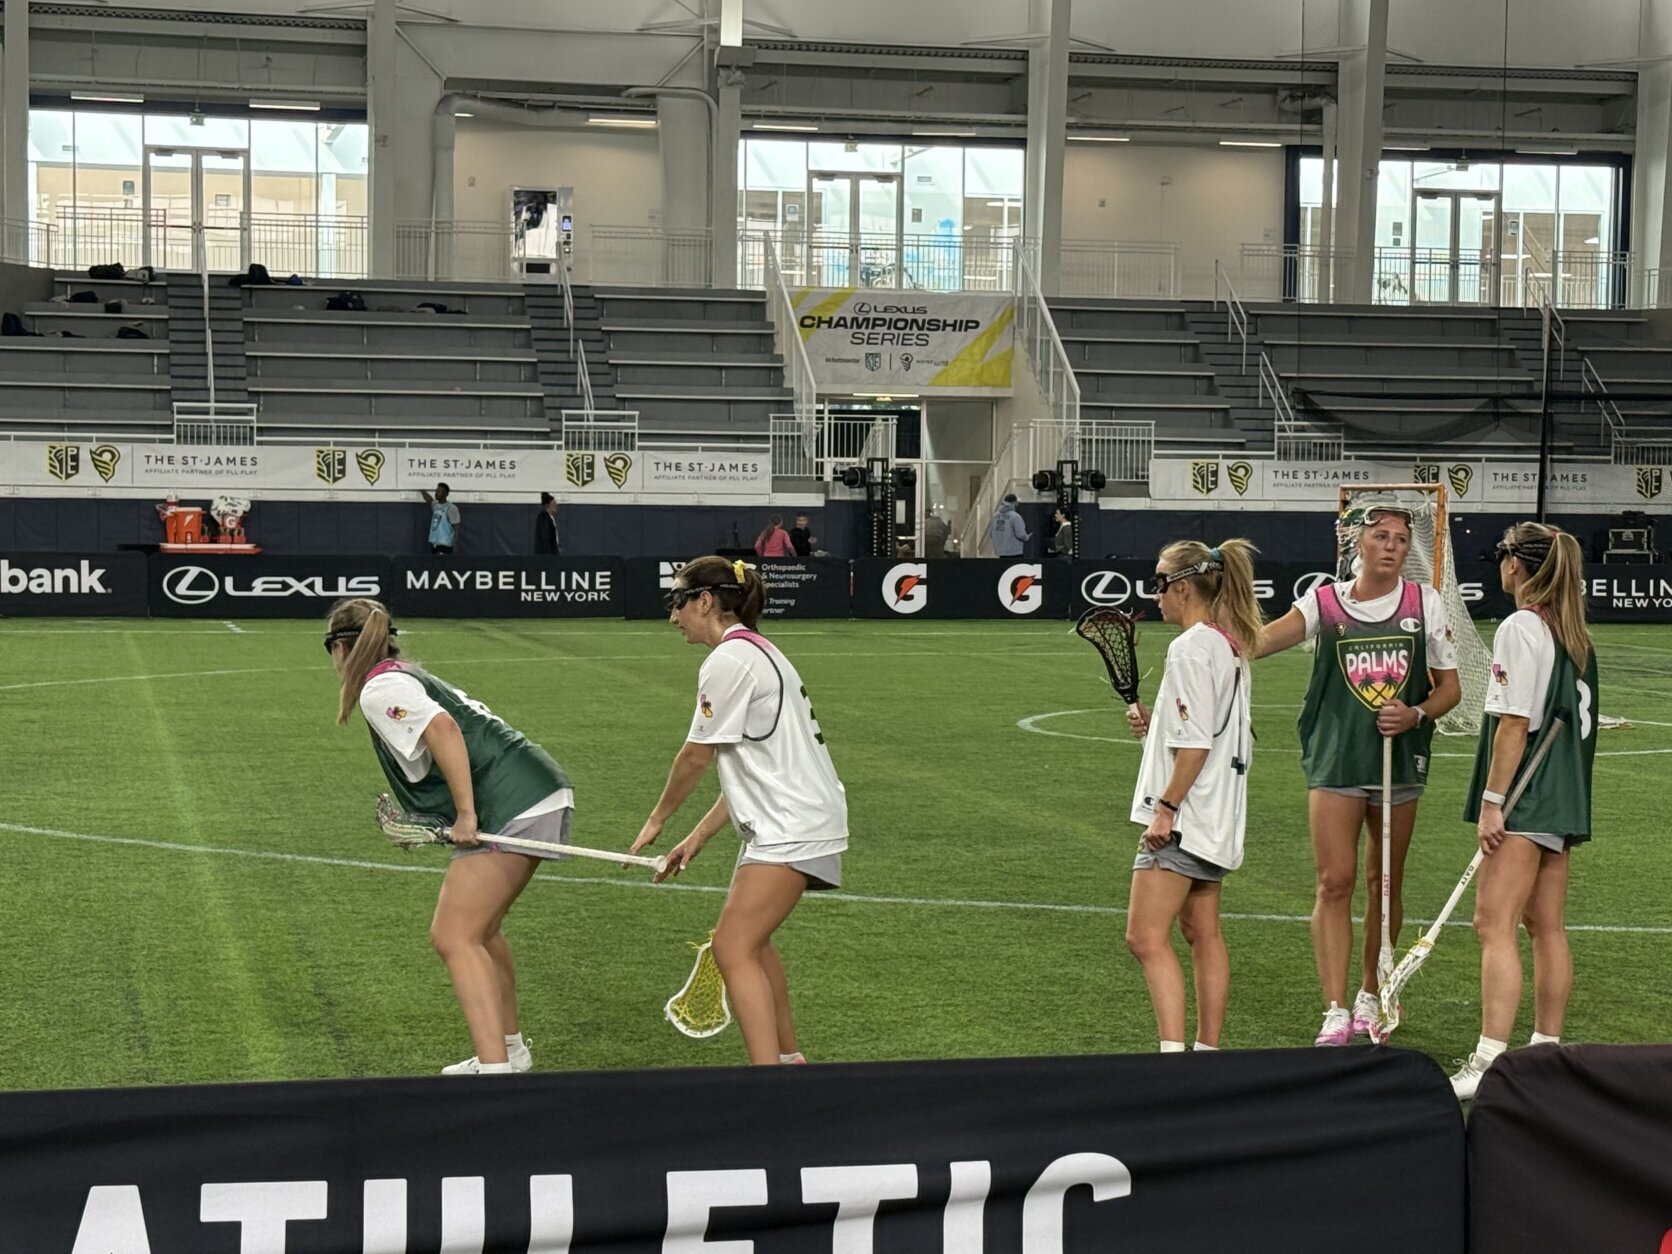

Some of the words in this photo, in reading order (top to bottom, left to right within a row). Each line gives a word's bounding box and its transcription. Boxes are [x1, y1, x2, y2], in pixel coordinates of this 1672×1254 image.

[874, 306, 928, 314] LEXUS
[800, 316, 980, 332] CHAMPIONSHIP
[850, 332, 930, 347] SERIES
[144, 455, 175, 466] THE
[408, 458, 437, 469] THE
[654, 462, 682, 472] THE
[1273, 470, 1298, 480] THE
[1492, 472, 1518, 482] THE
[1523, 473, 1588, 483] STAMES
[762, 564, 806, 572] Orthopaedic
[407, 570, 611, 589] MAYBELLINE
[769, 572, 817, 581] Neurosurgery
[225, 576, 380, 596] LEXUS
[521, 592, 560, 601] NEW
[564, 591, 610, 601] YORK
[769, 598, 796, 606] Training
[1613, 598, 1648, 608] NEW
[1346, 650, 1408, 676] PALMS
